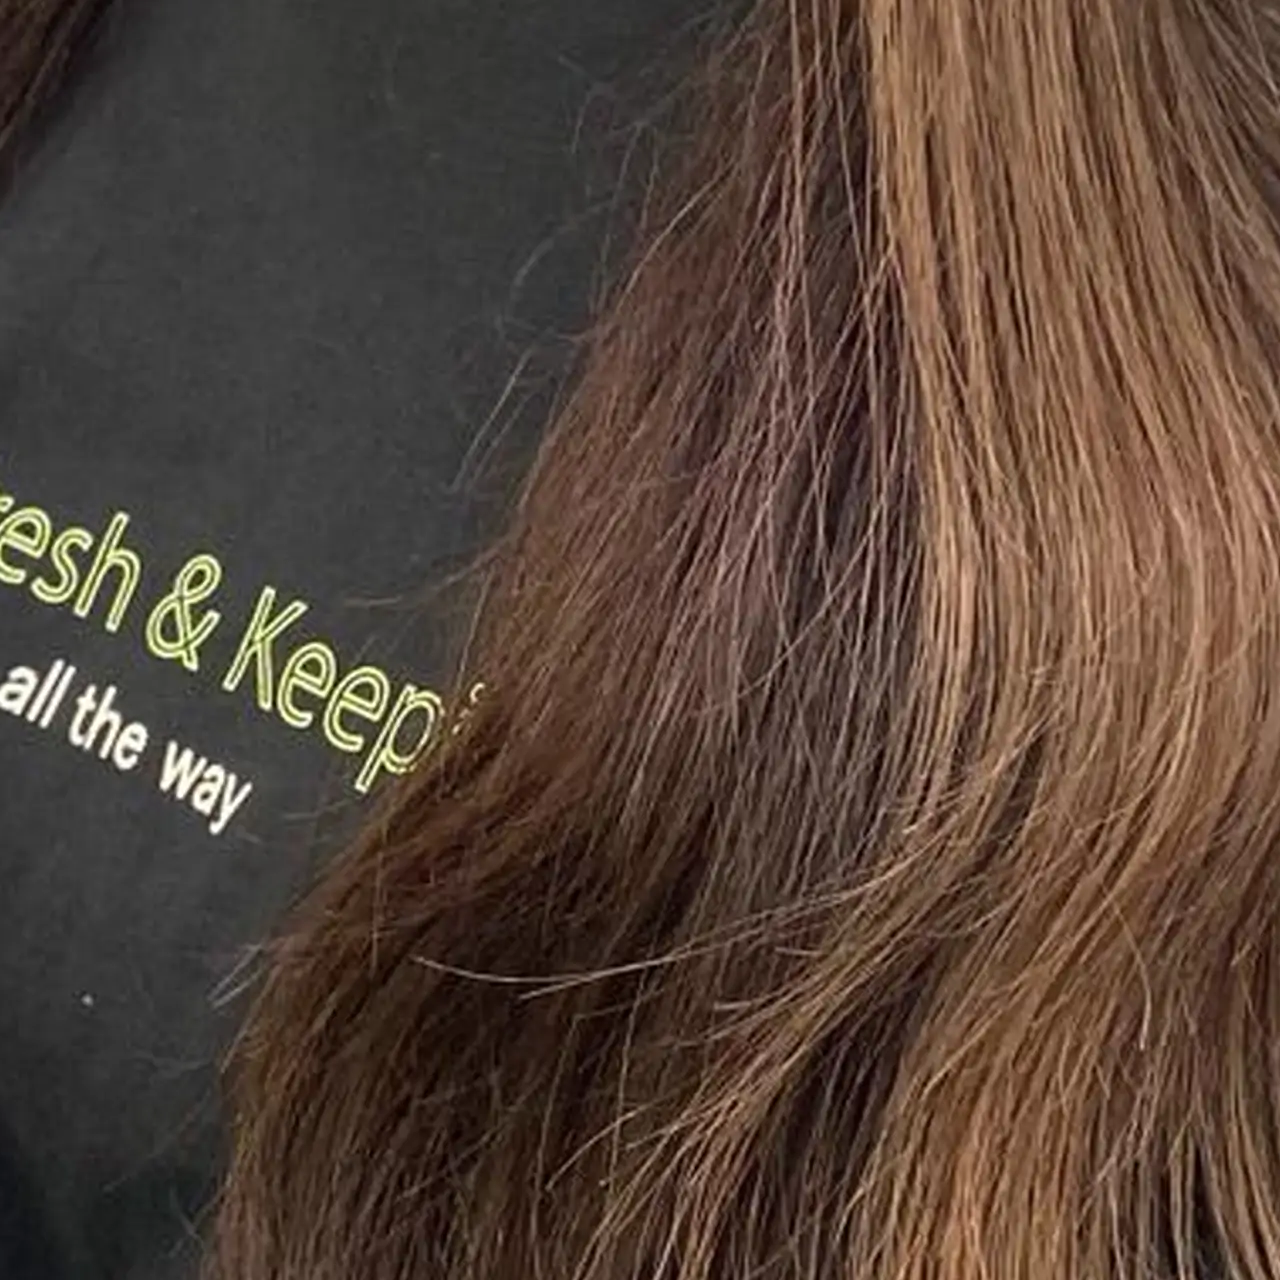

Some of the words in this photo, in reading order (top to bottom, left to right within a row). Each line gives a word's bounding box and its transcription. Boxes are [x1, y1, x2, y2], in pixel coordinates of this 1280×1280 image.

[68, 683, 150, 771] the
[158, 740, 254, 836] way
[145, 554, 223, 672] &
[222, 585, 485, 793] Keep
